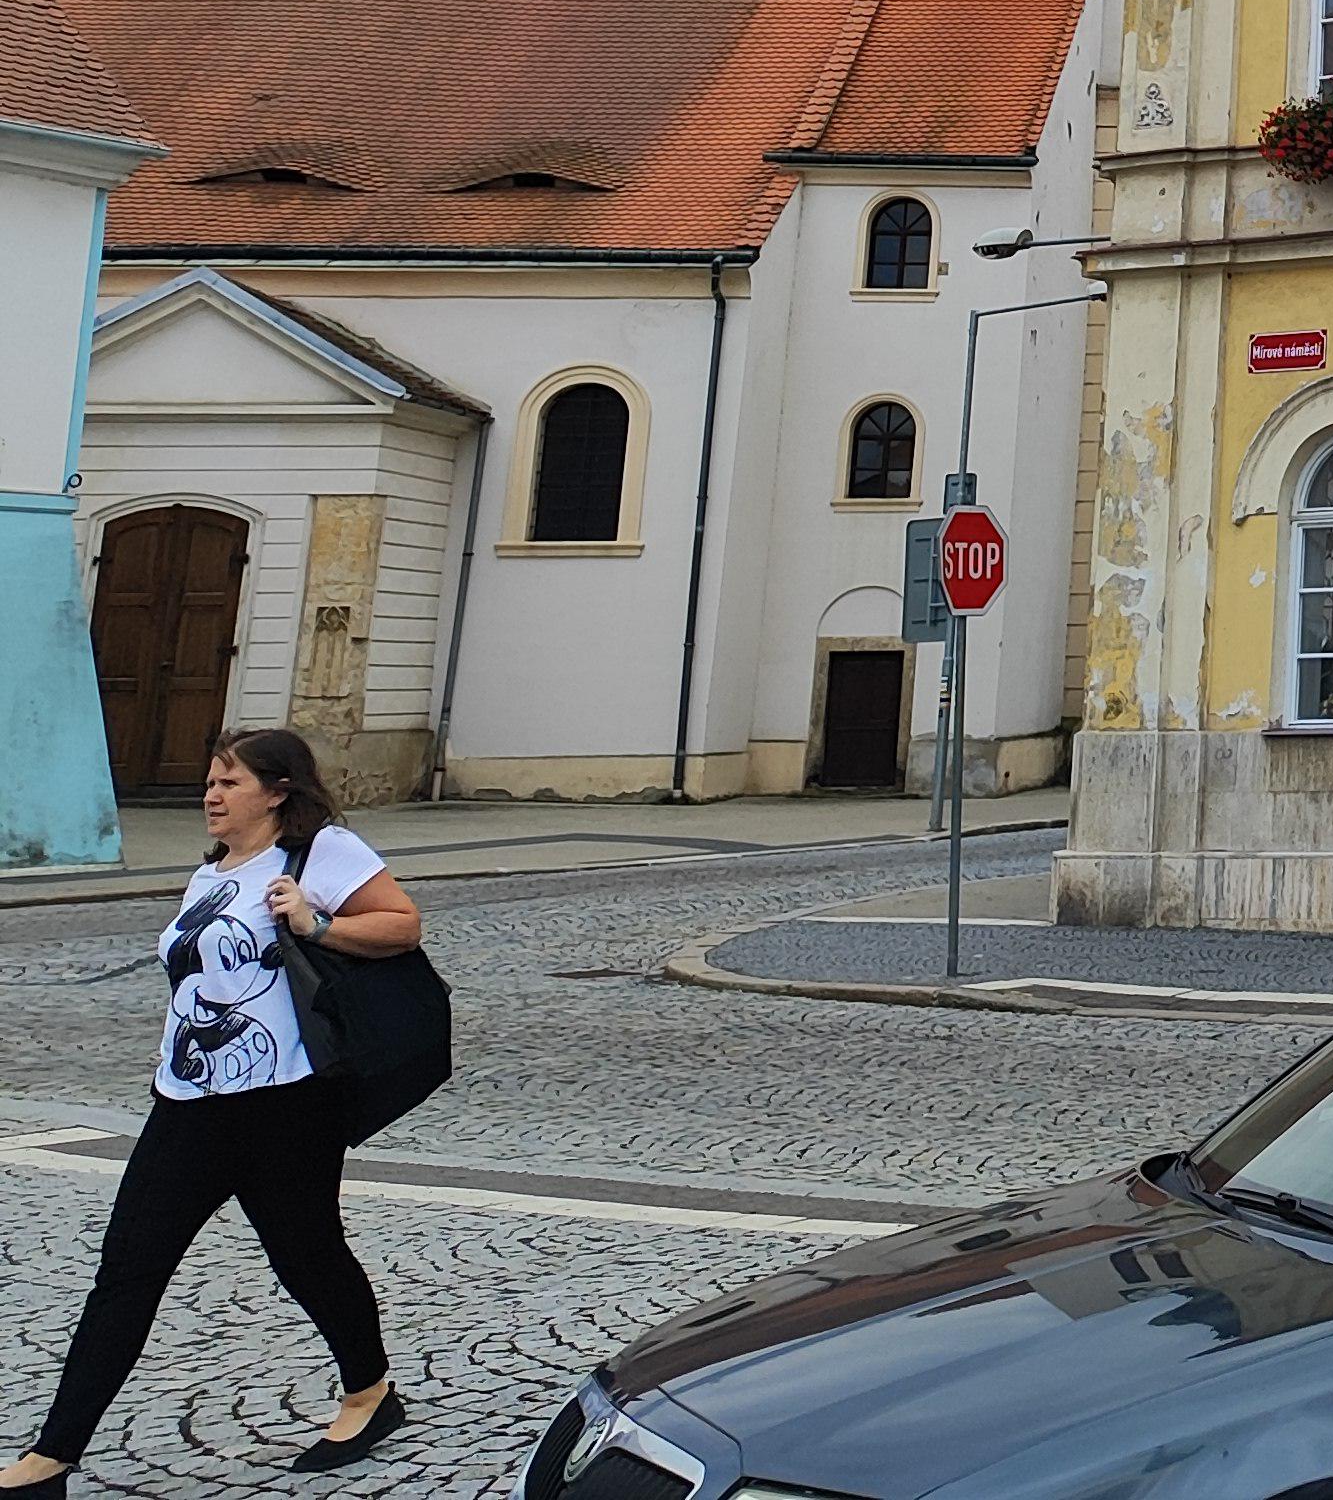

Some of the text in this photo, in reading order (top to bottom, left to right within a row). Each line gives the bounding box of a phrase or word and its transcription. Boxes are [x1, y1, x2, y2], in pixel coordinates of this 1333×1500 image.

[1252, 341, 1322, 360] Mírové náměstí
[944, 541, 1000, 580] STOP
